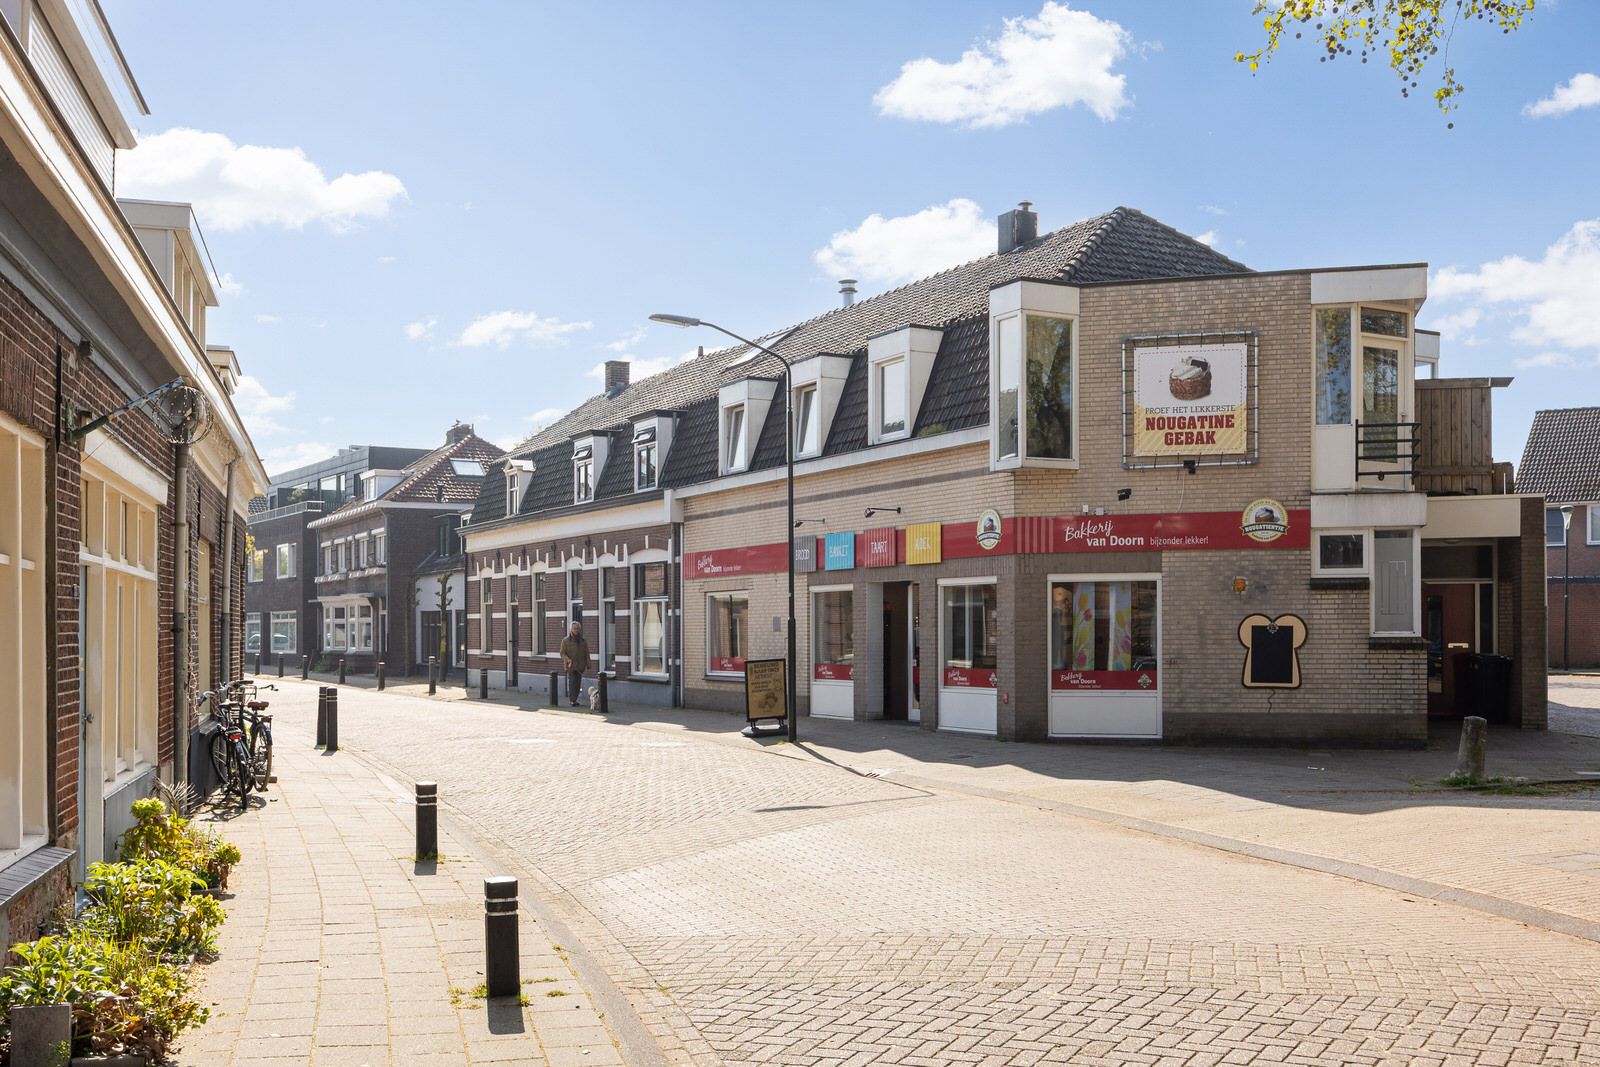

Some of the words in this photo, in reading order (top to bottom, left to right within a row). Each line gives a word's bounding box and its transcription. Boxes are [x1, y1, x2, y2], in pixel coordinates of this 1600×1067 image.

[1145, 406, 1170, 415] PROEF
[1172, 406, 1188, 414] HET
[1190, 404, 1236, 413] LEKKERSTE
[1145, 414, 1235, 431] NOUGATINE
[1164, 430, 1216, 446] GEBAK
[1064, 520, 1113, 542] Bakkerij
[870, 540, 888, 554] TAART
[1086, 537, 1106, 546] van
[1110, 536, 1144, 546] Doorn
[1150, 537, 1183, 547] bijzonder
[1185, 535, 1209, 545] lekker!
[795, 549, 810, 561] BROOD
